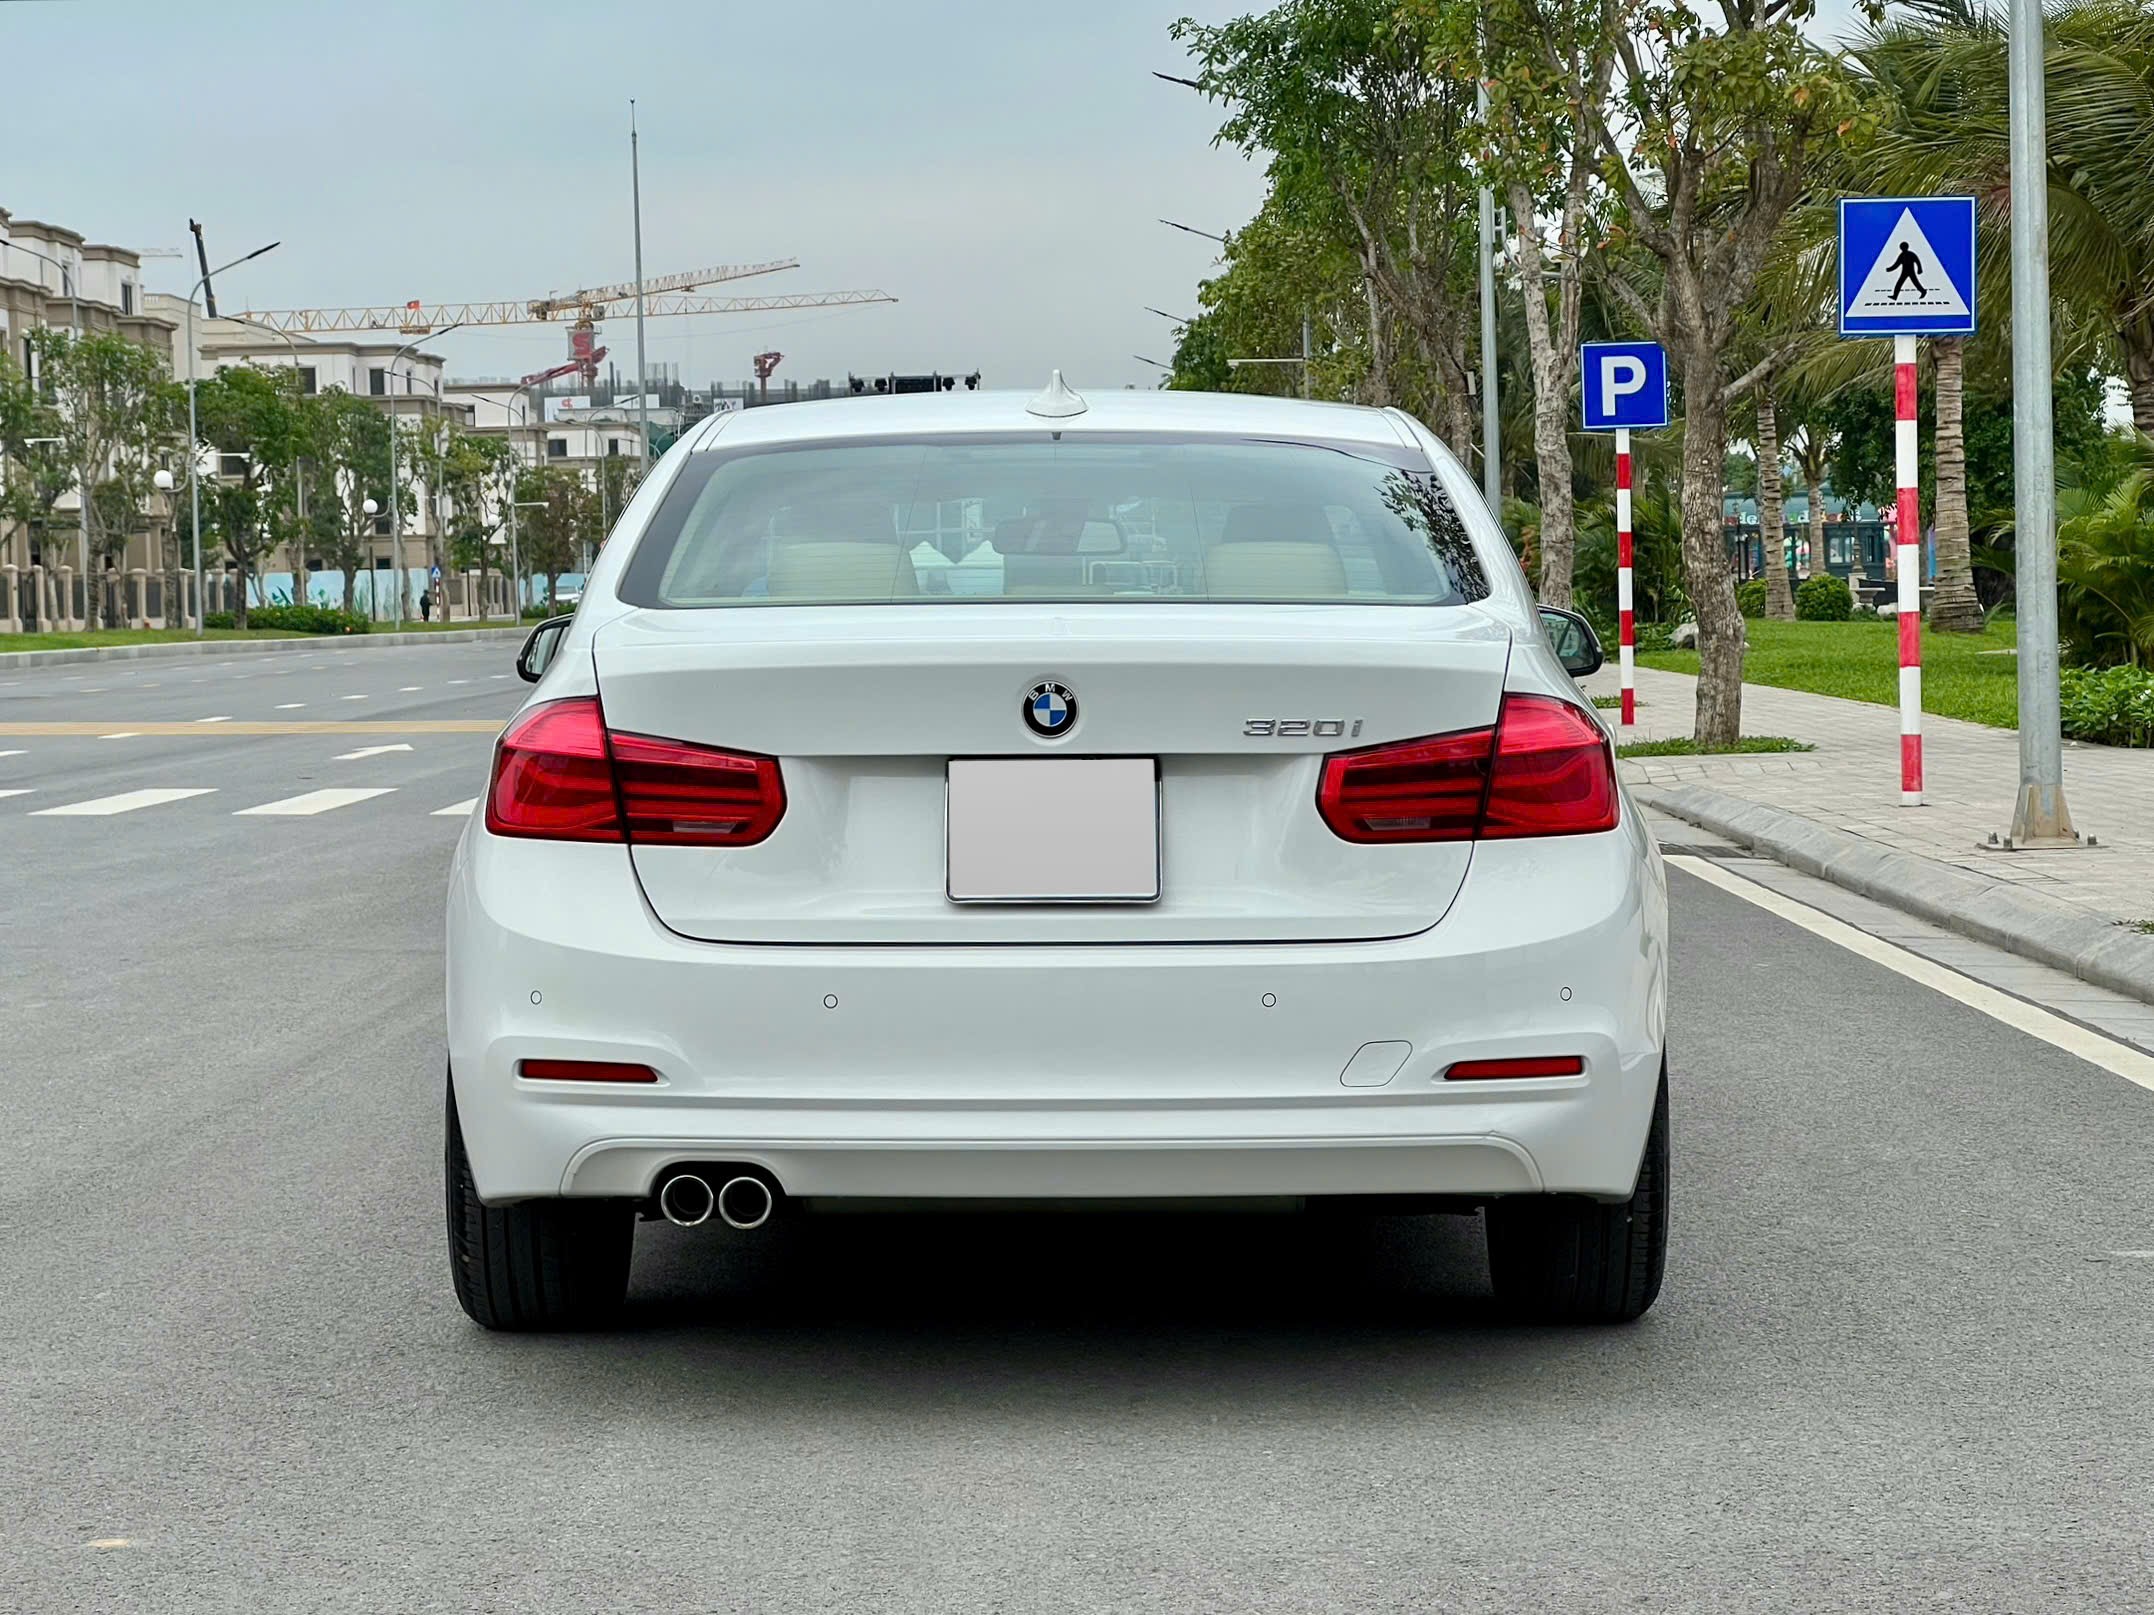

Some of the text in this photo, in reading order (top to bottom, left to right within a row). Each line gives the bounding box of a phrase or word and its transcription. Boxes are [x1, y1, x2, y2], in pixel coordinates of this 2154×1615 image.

[1601, 355, 1646, 416] P
[1028, 683, 1073, 701] BMW
[1243, 718, 1363, 737] 320i
